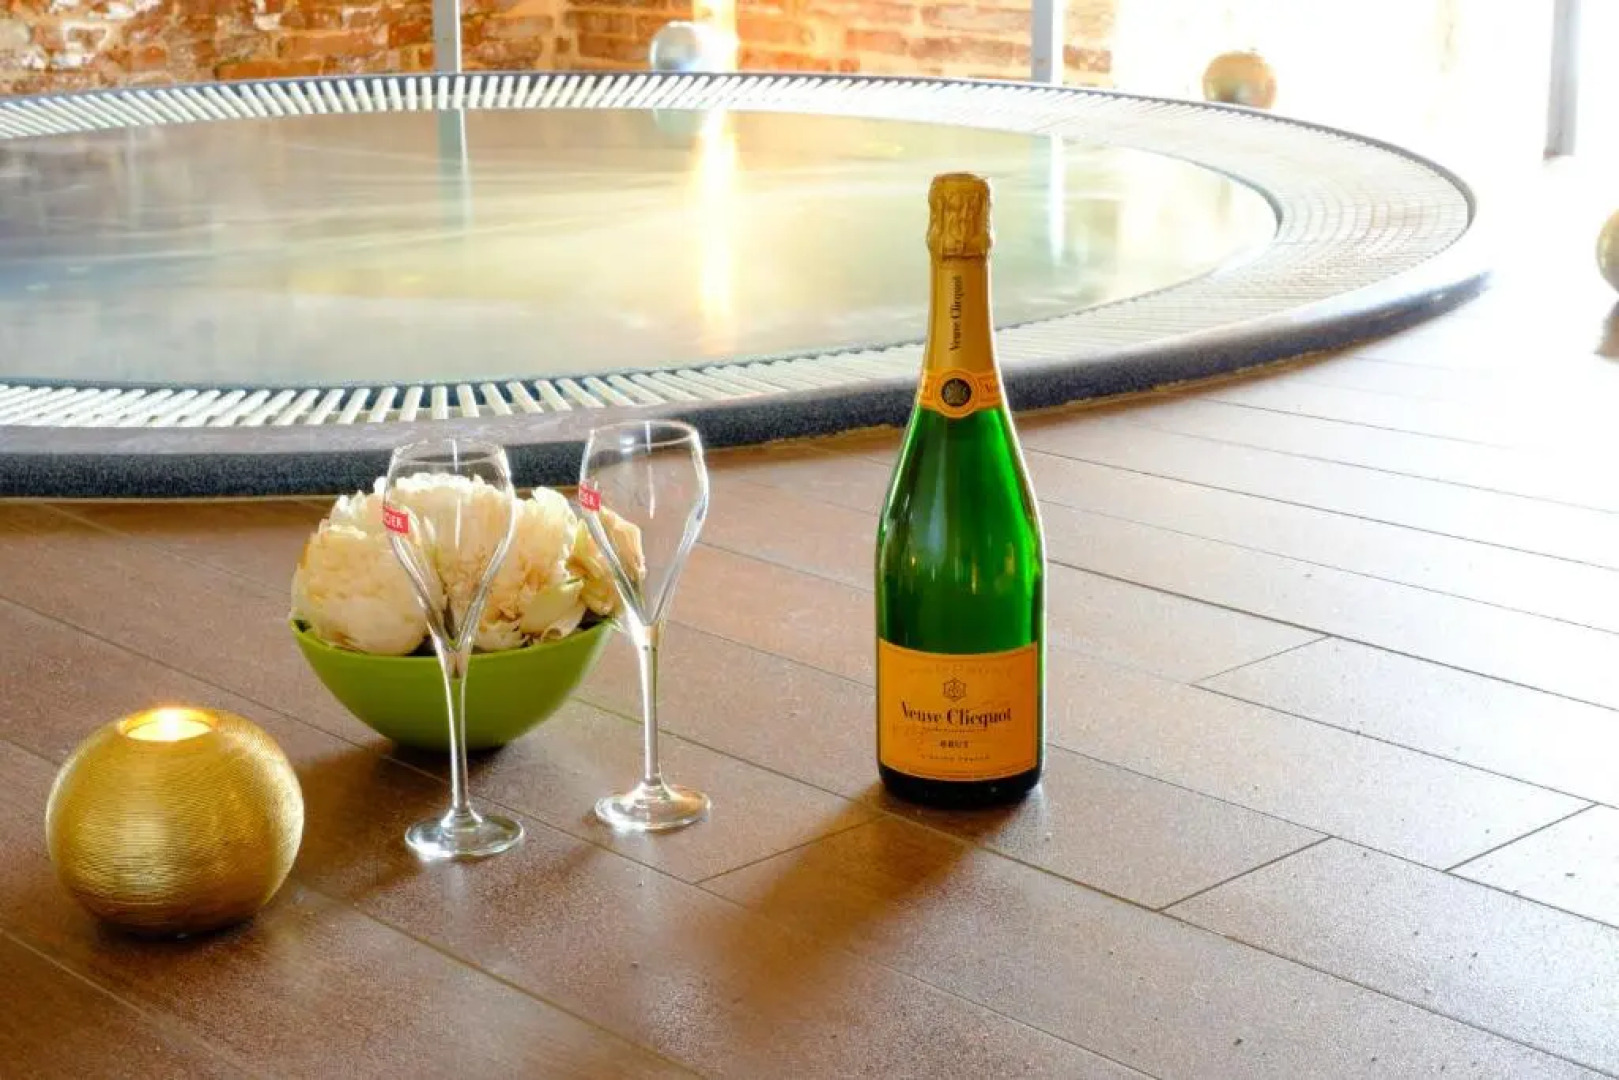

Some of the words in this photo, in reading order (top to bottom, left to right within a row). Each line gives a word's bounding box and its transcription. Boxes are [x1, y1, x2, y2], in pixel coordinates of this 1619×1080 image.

[950, 275, 965, 319] Clicquot
[949, 322, 962, 351] Veuve
[902, 701, 942, 721] Veuve
[947, 707, 1012, 728] Clicquot
[940, 739, 969, 748] BRUT
